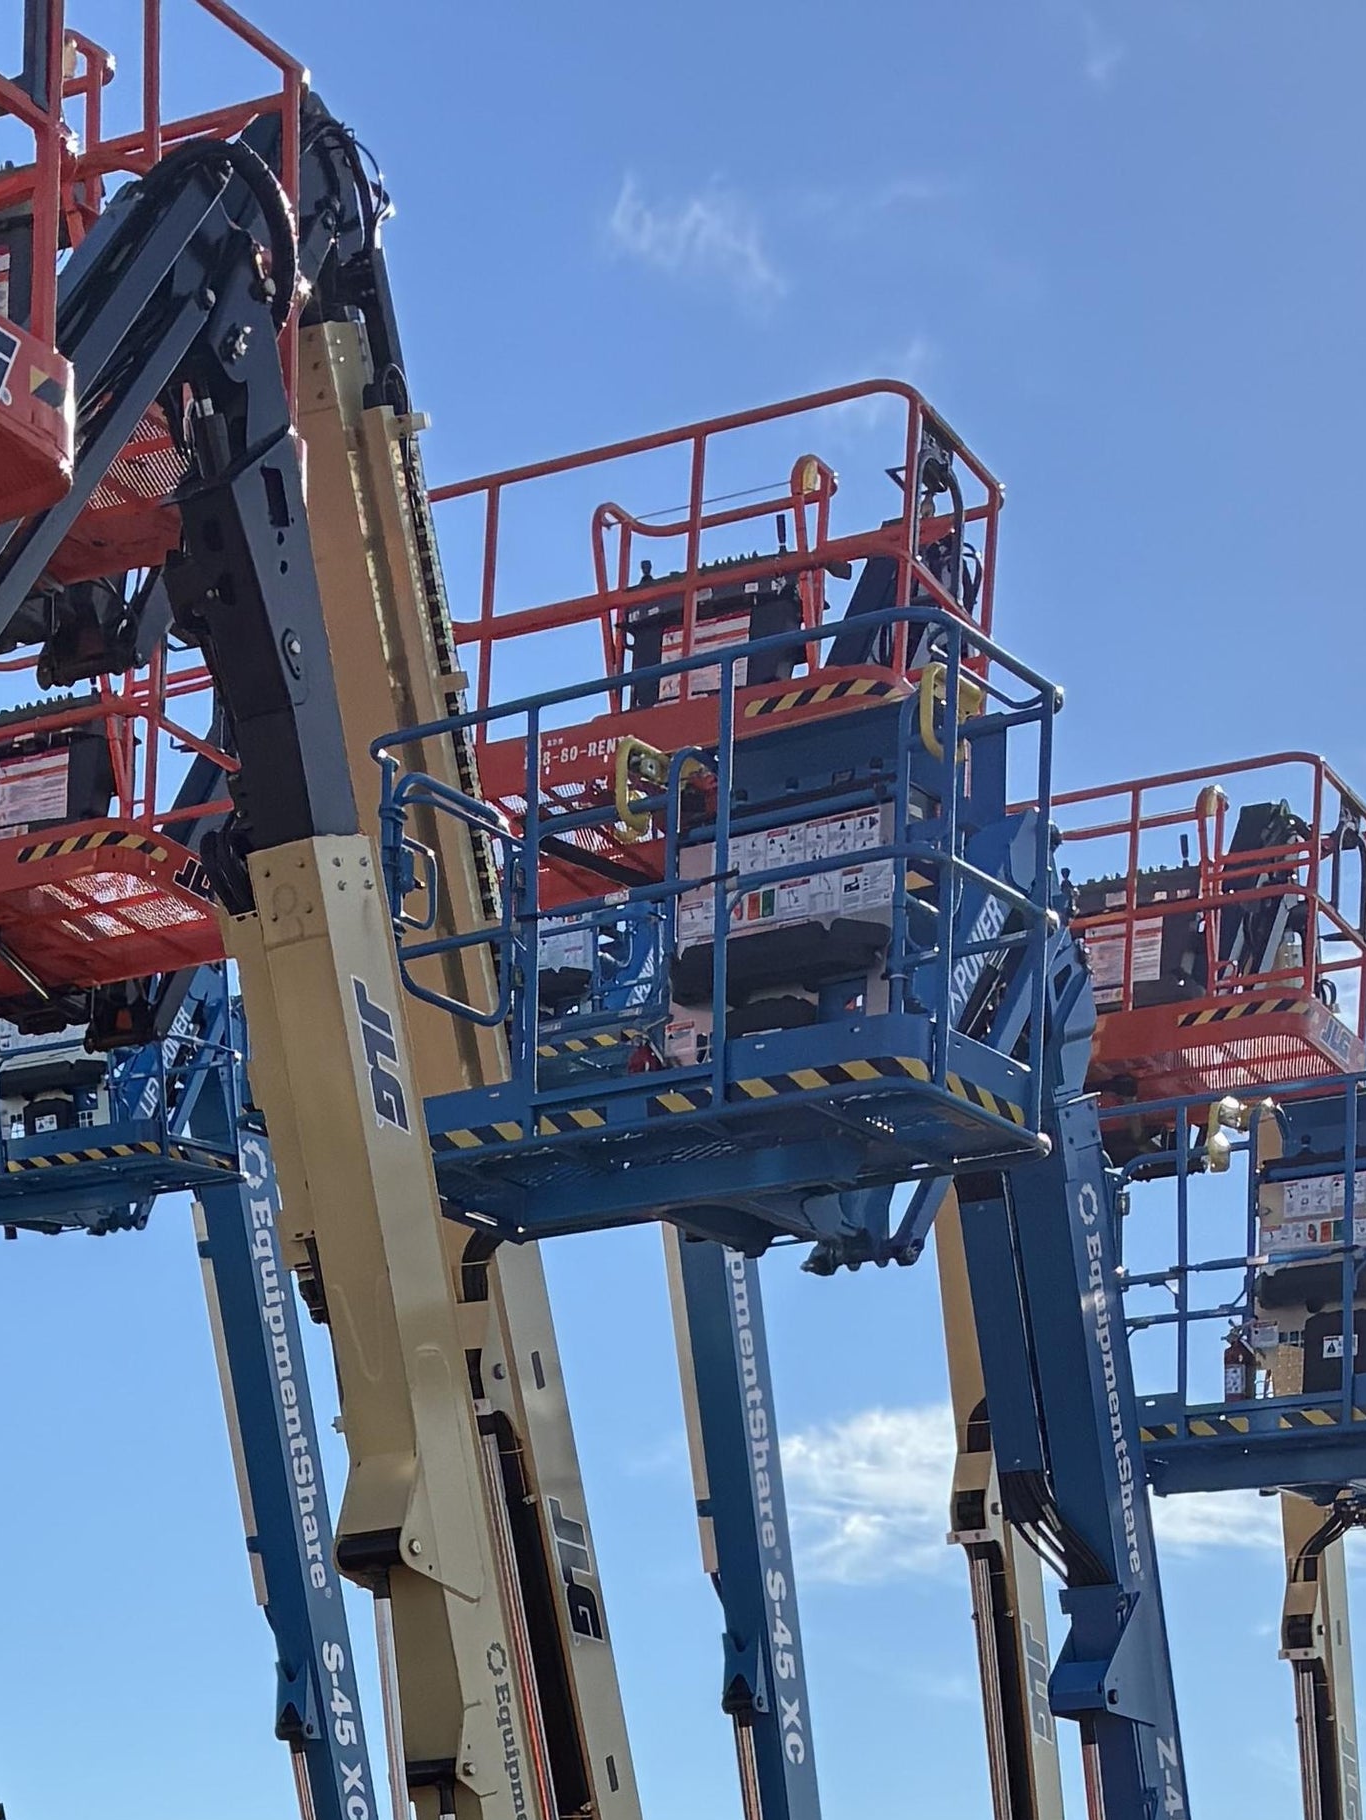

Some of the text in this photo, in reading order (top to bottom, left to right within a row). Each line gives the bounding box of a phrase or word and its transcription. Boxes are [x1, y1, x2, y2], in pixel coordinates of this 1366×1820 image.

[351, 975, 412, 1135] JLG
[1320, 1016, 1352, 1063] JLG
[1084, 1232, 1141, 1577] EquipmentShare
[249, 1199, 326, 1590] EquipmentShare
[323, 1640, 357, 1748] S-45
[545, 1495, 606, 1642] JLG
[765, 1569, 797, 1682] S-45
[778, 1696, 805, 1766] XC
[1023, 1618, 1055, 1745] JLG
